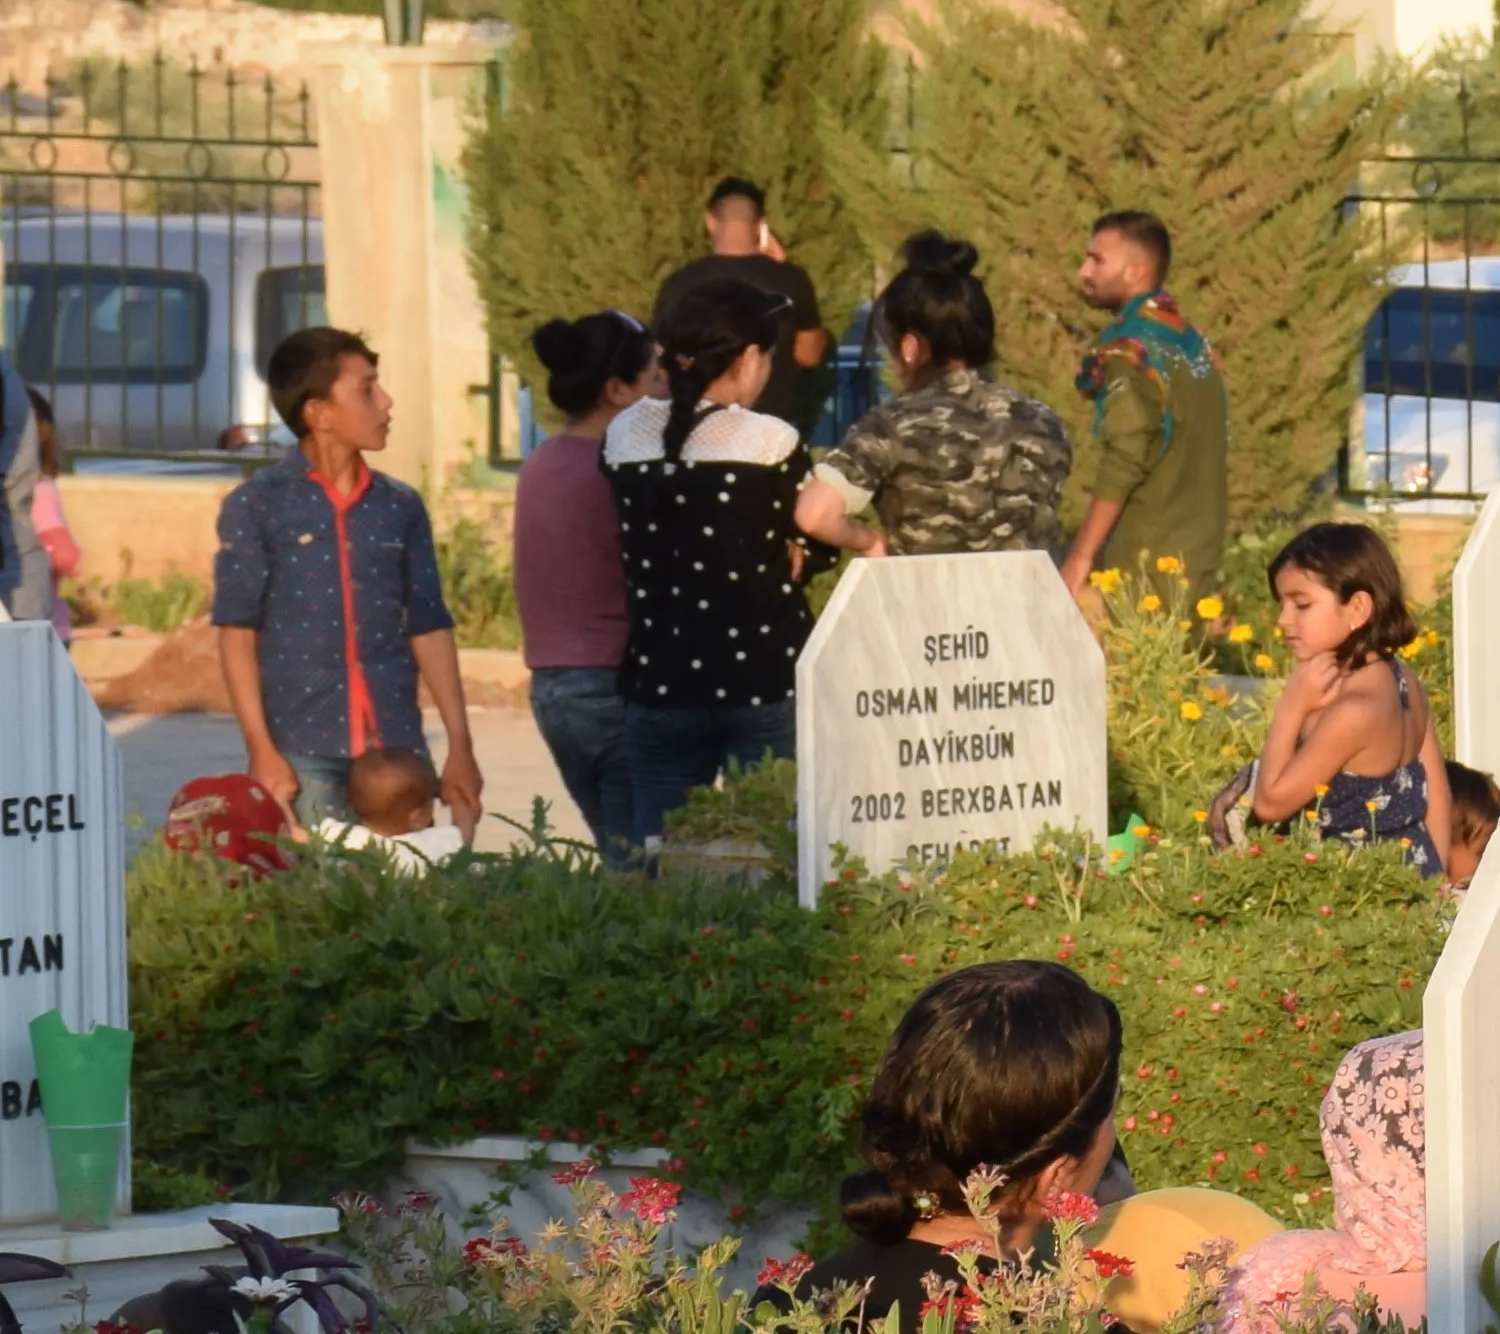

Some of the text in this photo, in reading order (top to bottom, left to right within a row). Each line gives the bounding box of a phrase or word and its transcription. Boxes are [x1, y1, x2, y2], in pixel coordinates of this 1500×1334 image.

[856, 687, 938, 717] OSMAN
[0, 794, 85, 842] EÇEL
[851, 780, 1062, 822] 2002 BERXBATAN
[0, 934, 64, 976] TAN
